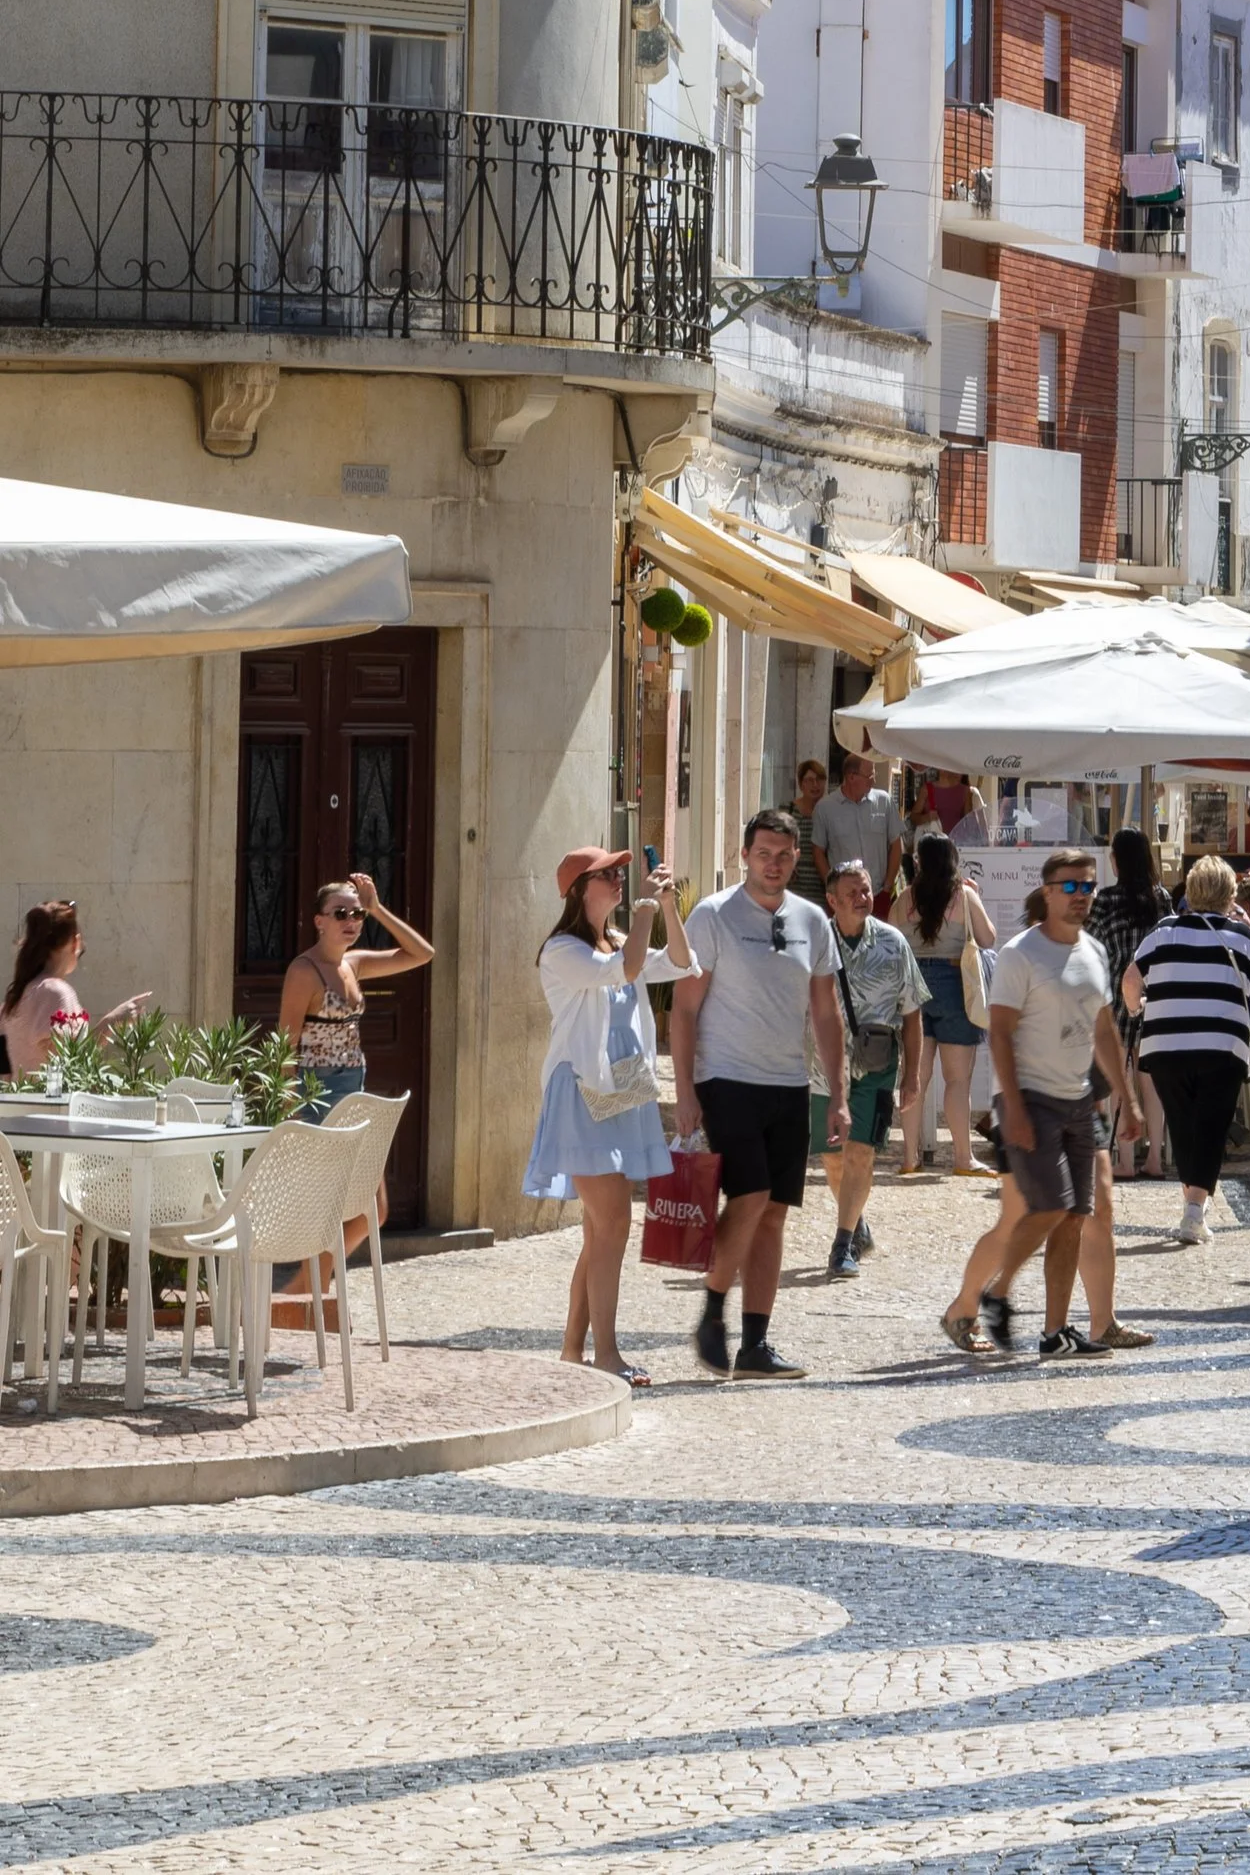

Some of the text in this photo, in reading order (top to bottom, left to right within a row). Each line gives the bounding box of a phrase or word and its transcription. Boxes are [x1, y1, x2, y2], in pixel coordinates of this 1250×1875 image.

[346, 467, 386, 480] AFIXAÇÃO
[345, 481, 385, 493] PROIBIDA
[991, 872, 1019, 880] MENU
[654, 1197, 708, 1224] RIVERA
